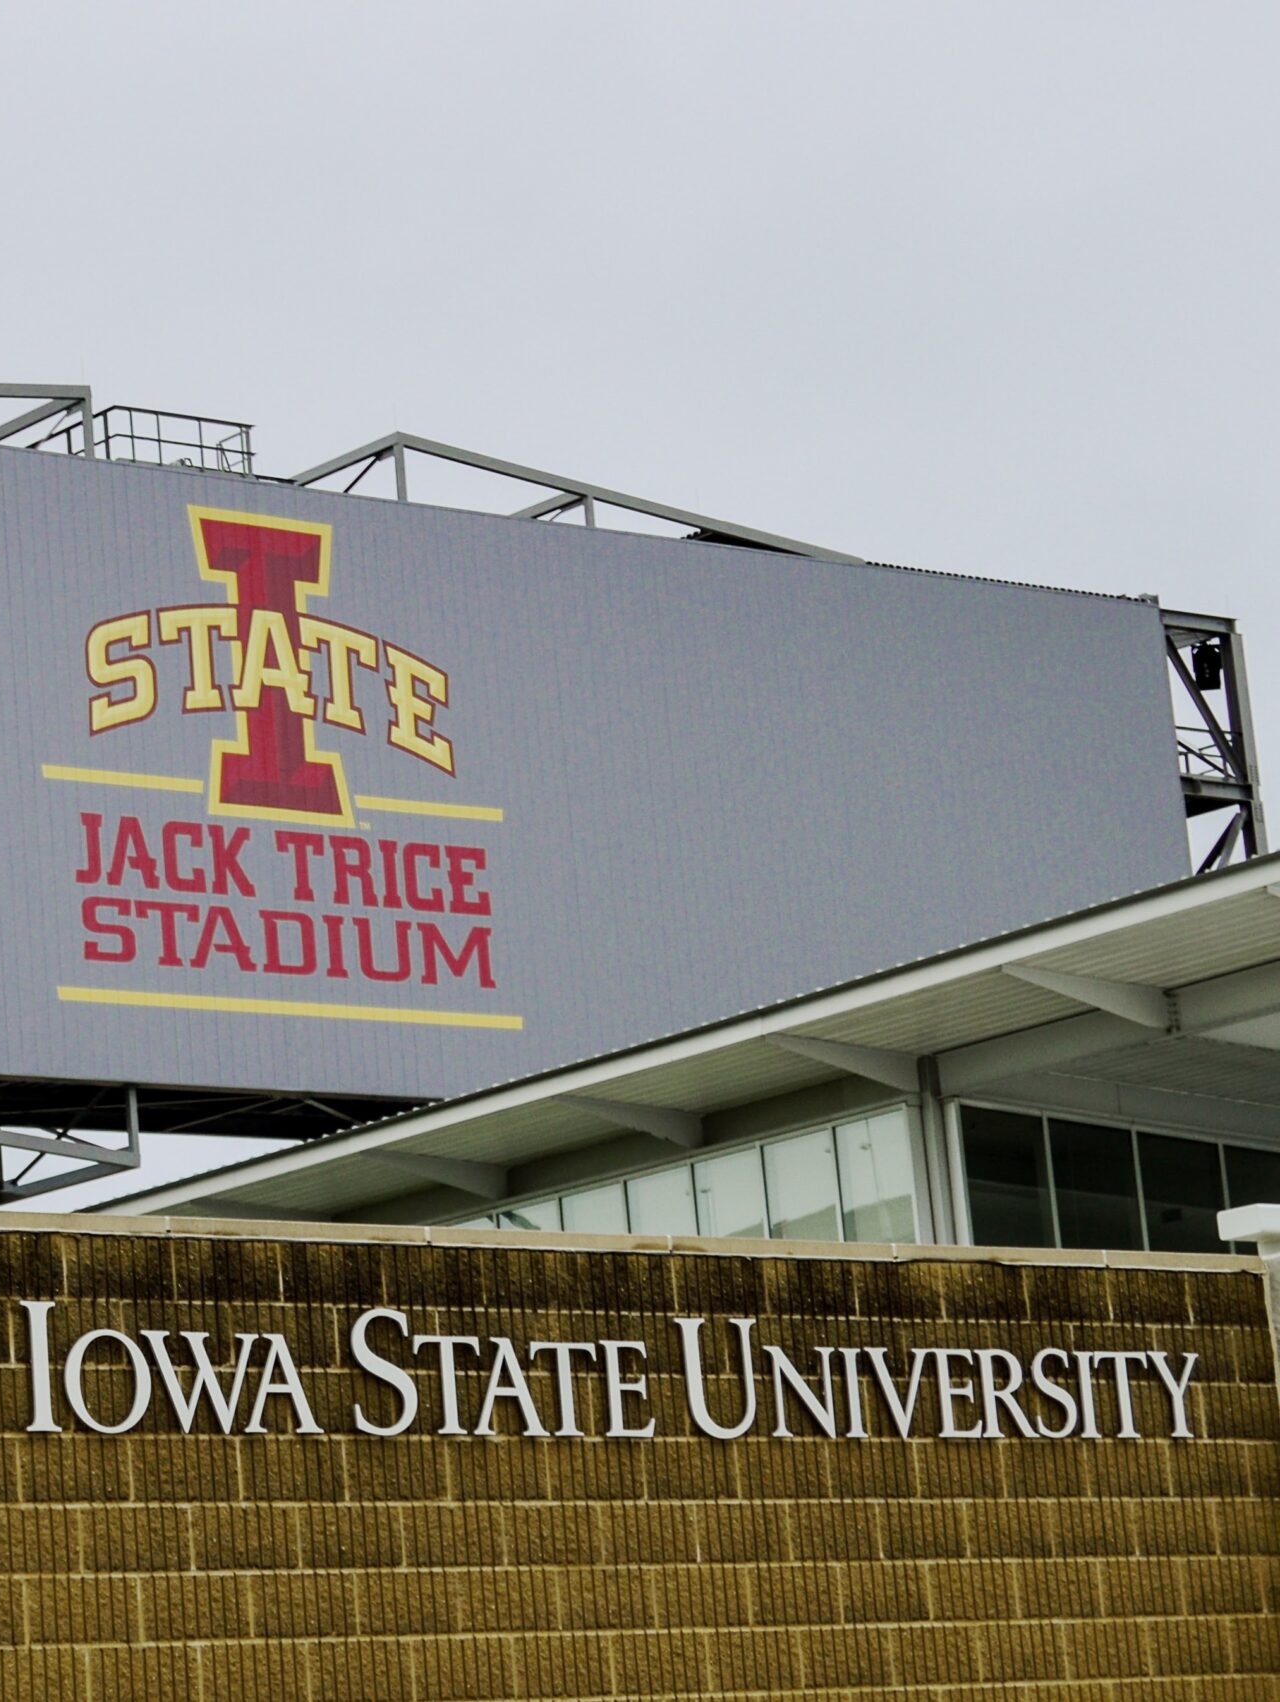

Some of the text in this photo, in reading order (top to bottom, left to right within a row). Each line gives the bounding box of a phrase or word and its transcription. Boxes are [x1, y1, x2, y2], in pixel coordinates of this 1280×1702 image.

[85, 603, 456, 778] STATE
[76, 812, 492, 916] JACK TRICE
[81, 896, 496, 989] STADIUM
[21, 1300, 1199, 1441] IOWA STATE UNIVERSITY
